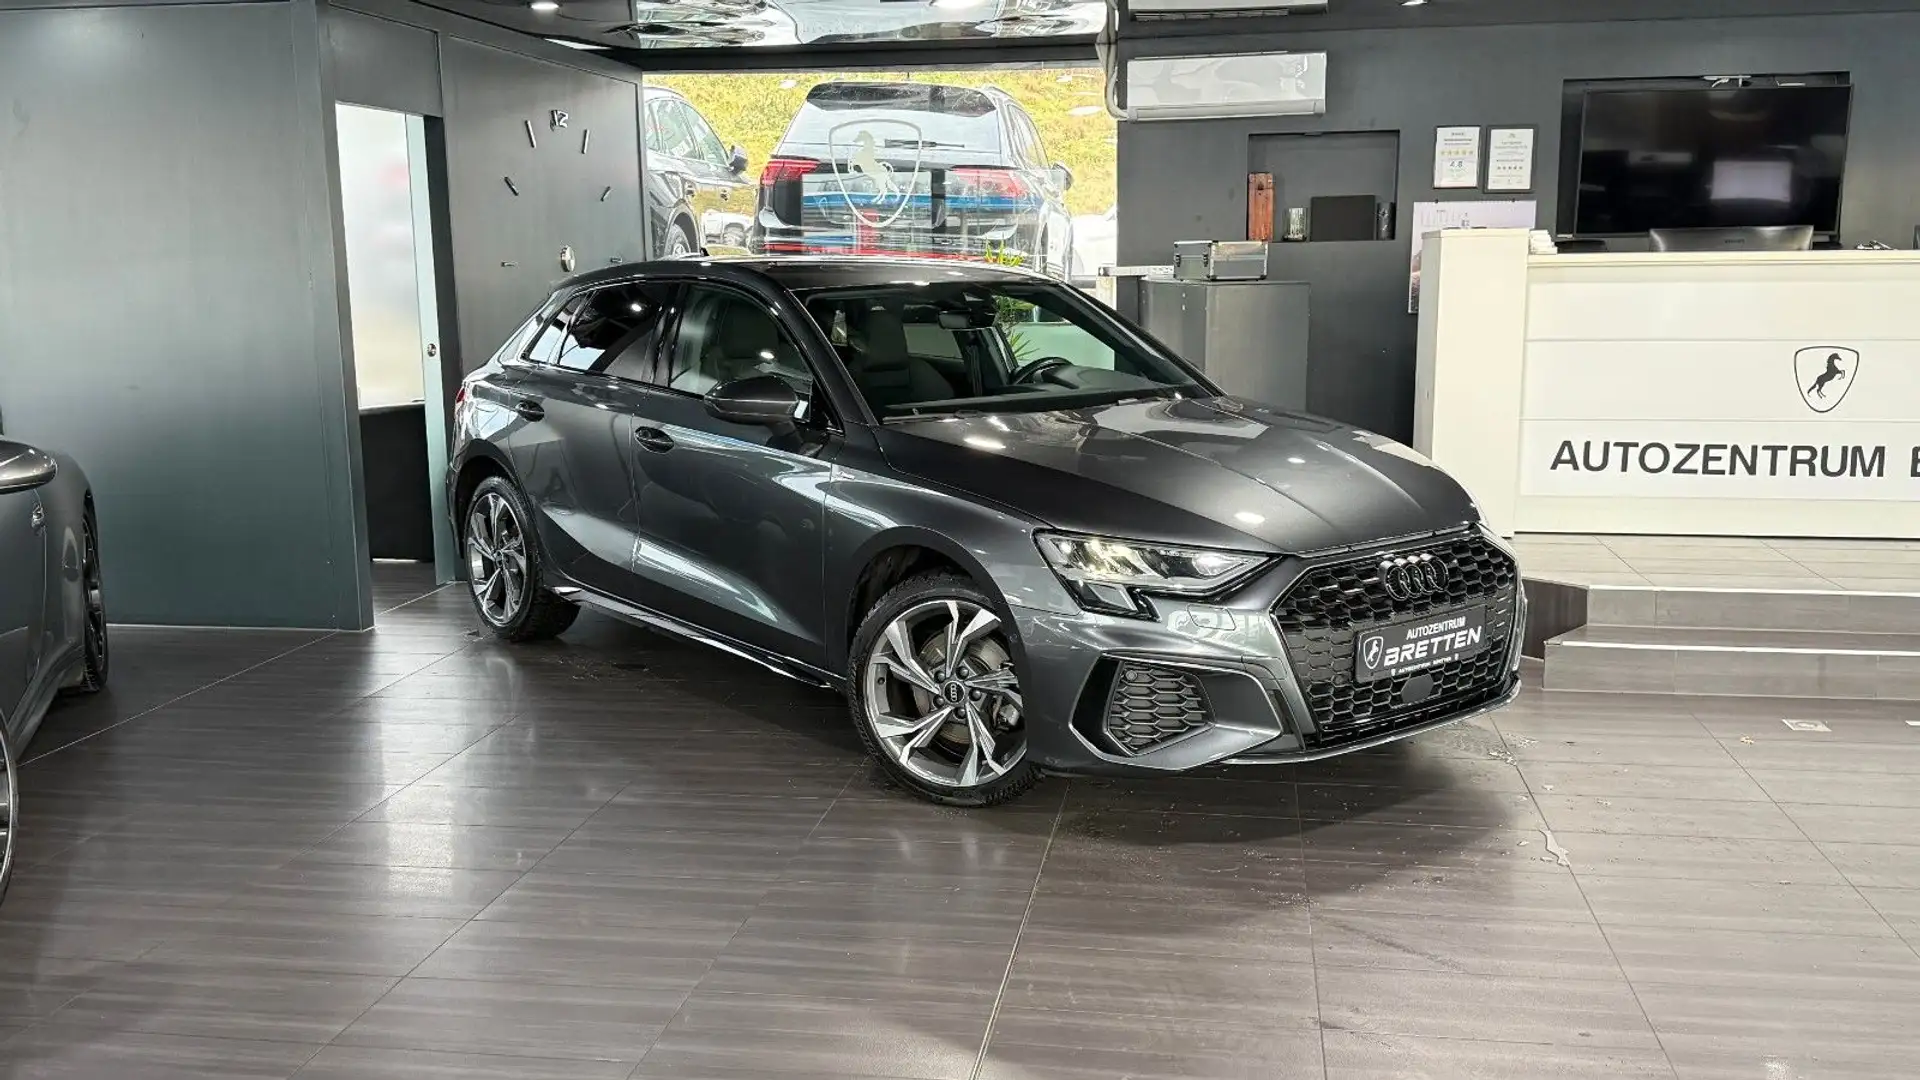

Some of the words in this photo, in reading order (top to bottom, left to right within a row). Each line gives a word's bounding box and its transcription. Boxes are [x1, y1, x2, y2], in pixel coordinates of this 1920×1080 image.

[550, 109, 568, 128] 12
[1550, 440, 1885, 478] AUTOZENTRUM
[1406, 616, 1466, 640] AUTOZENTRUM
[1384, 626, 1482, 667] BRETTEN
